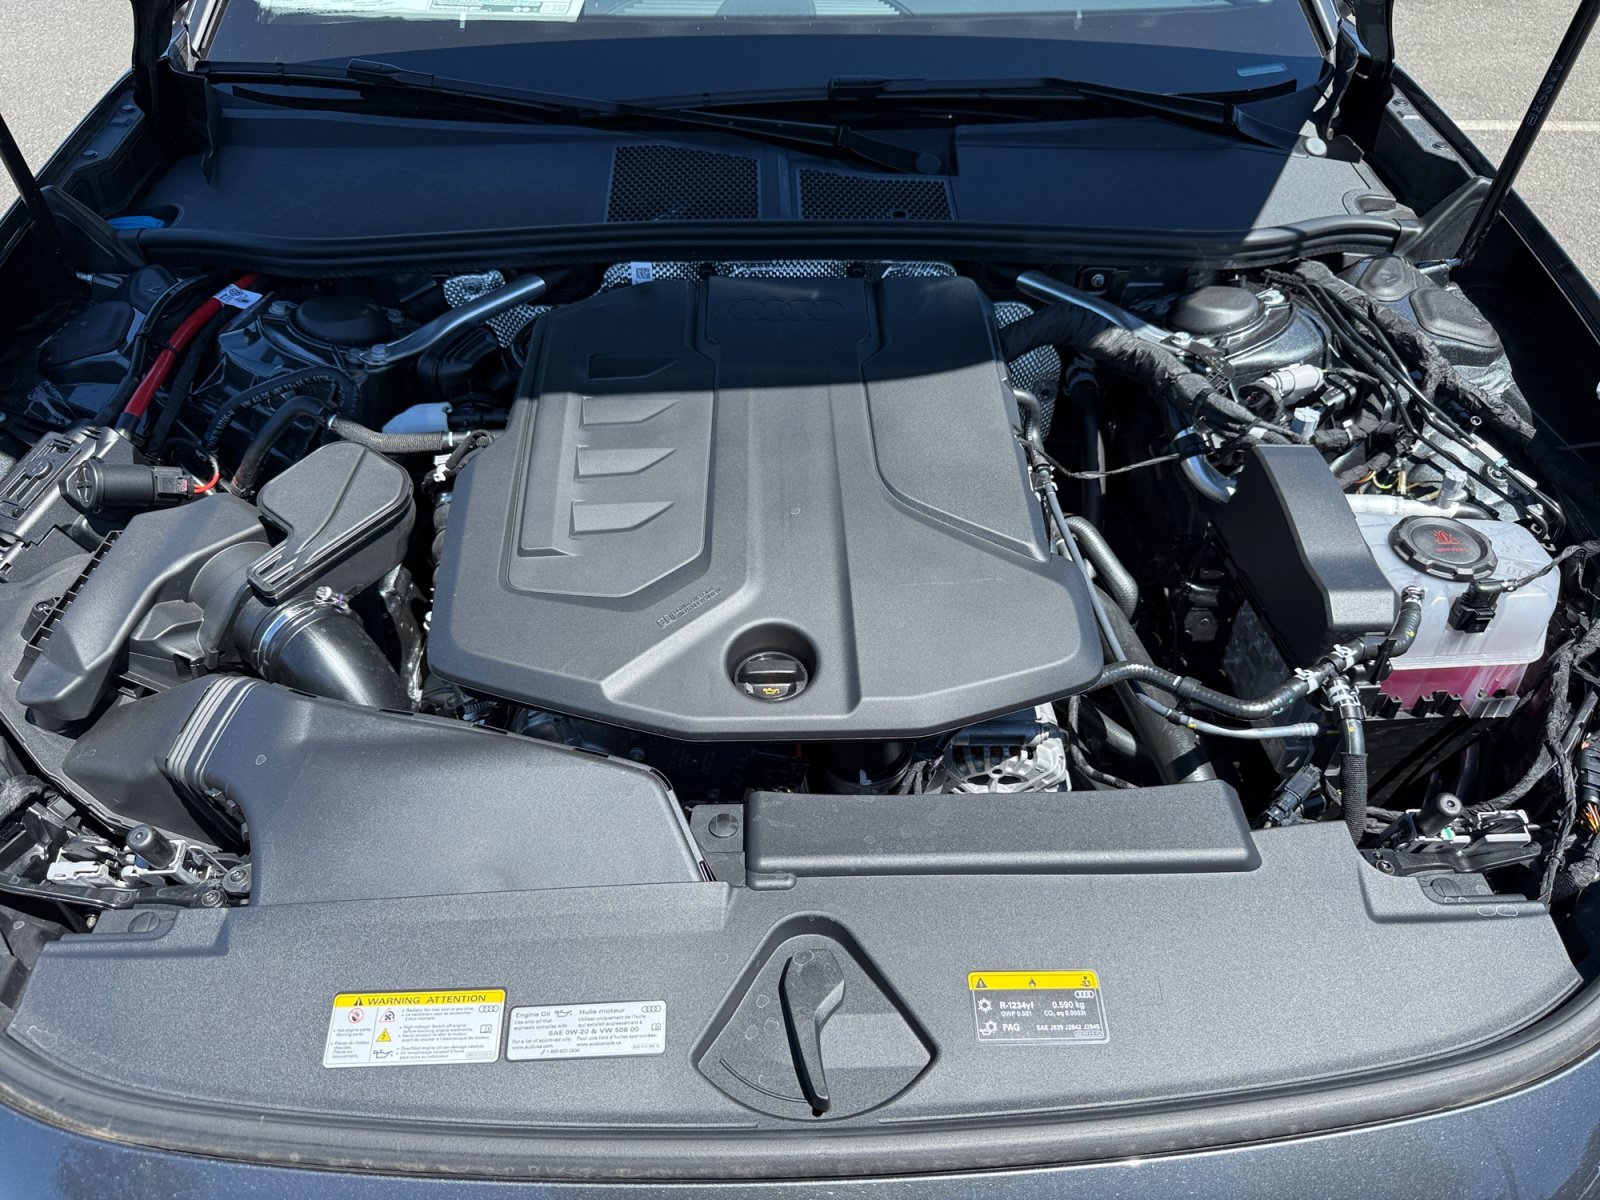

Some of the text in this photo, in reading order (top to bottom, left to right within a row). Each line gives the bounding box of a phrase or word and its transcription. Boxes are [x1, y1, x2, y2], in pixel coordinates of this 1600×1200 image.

[368, 994, 486, 1005] WARNING ATTENTION
[1000, 1001, 1034, 1010] R-1234yf
[1076, 1001, 1085, 1010] kg
